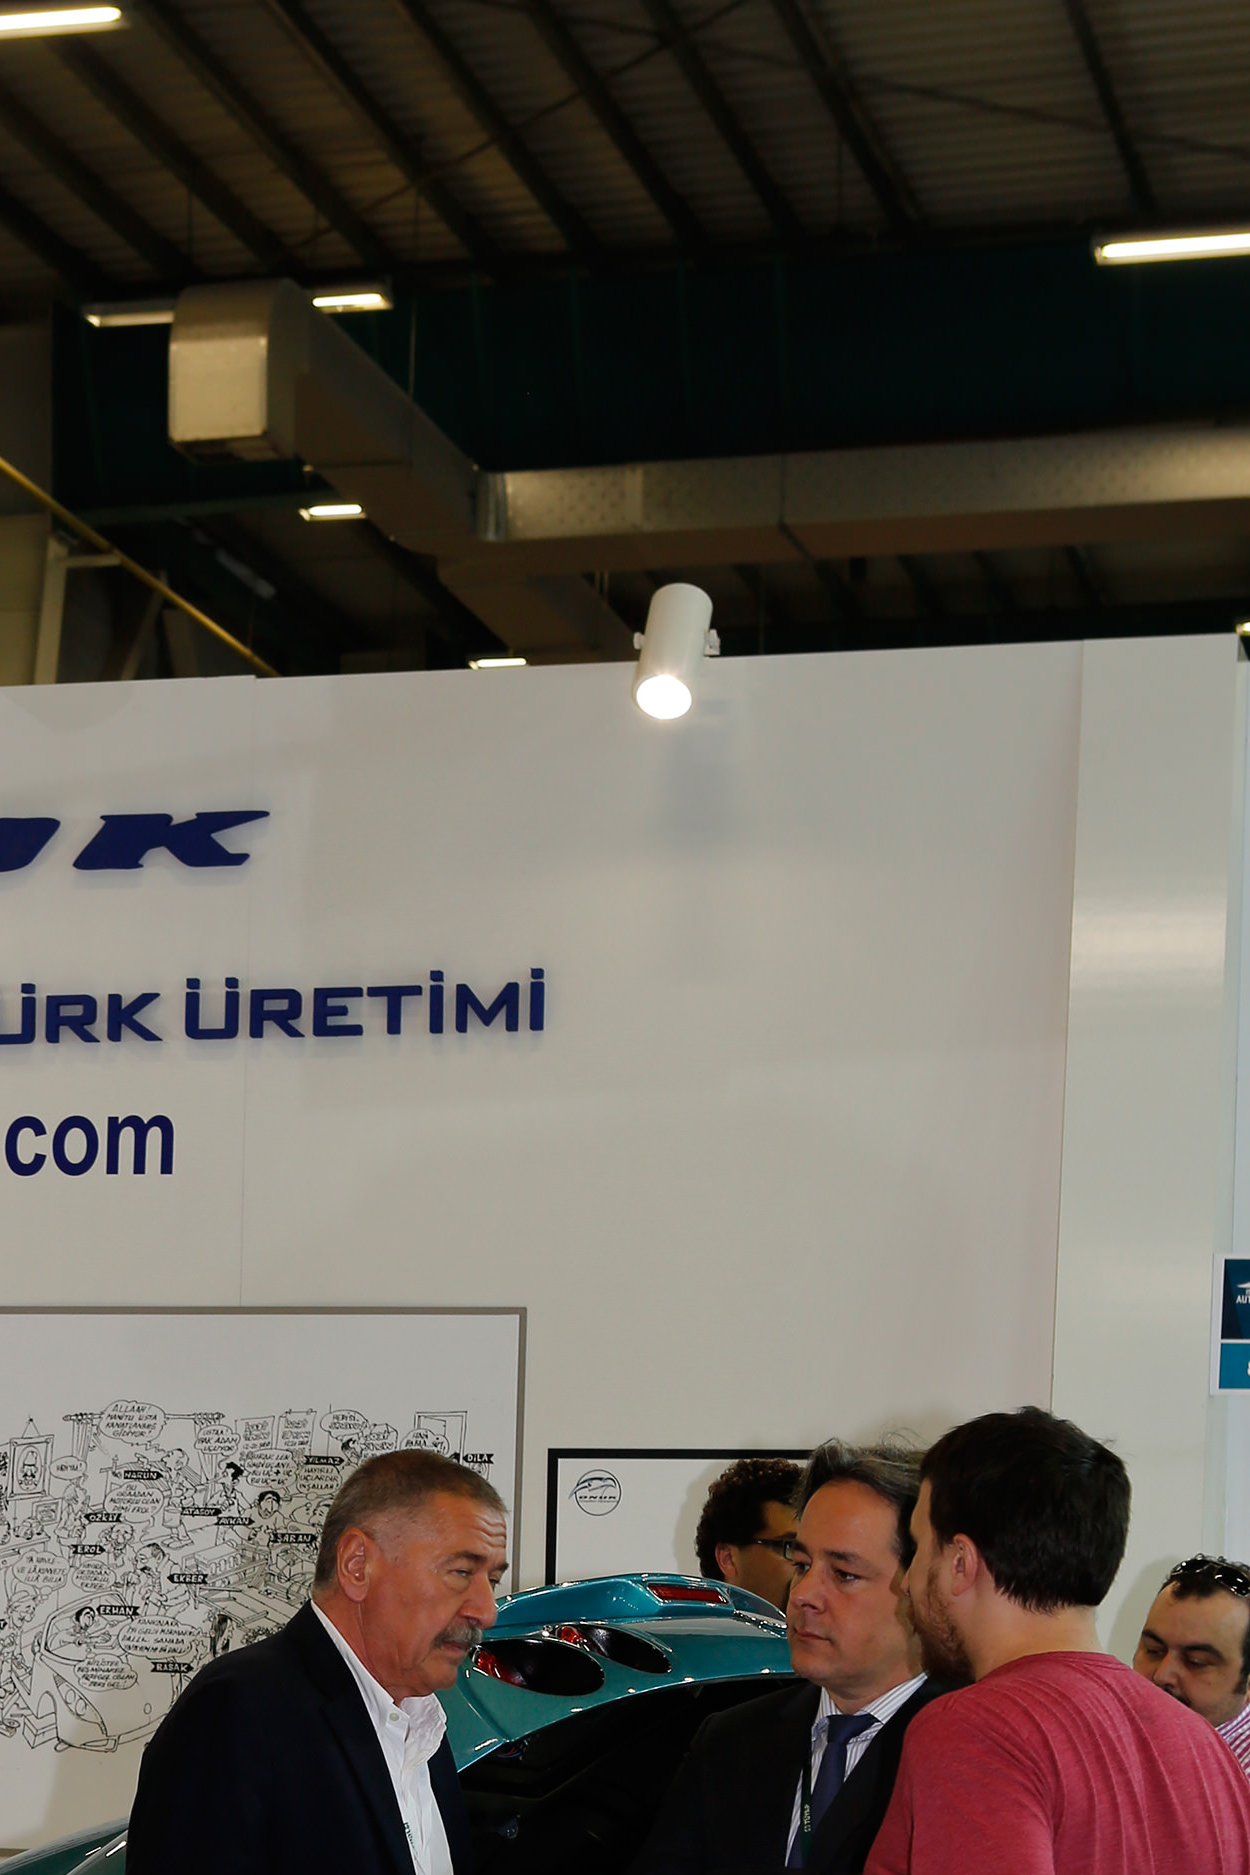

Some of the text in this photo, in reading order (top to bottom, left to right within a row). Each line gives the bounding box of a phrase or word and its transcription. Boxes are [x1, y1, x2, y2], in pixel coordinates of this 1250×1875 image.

[186, 968, 545, 1040] ÜRETİMİ
[124, 1471, 157, 1480] HARUN
[182, 1508, 216, 1516] ATASOY
[76, 1545, 102, 1554] EROL
[99, 1606, 135, 1616] ERHAN
